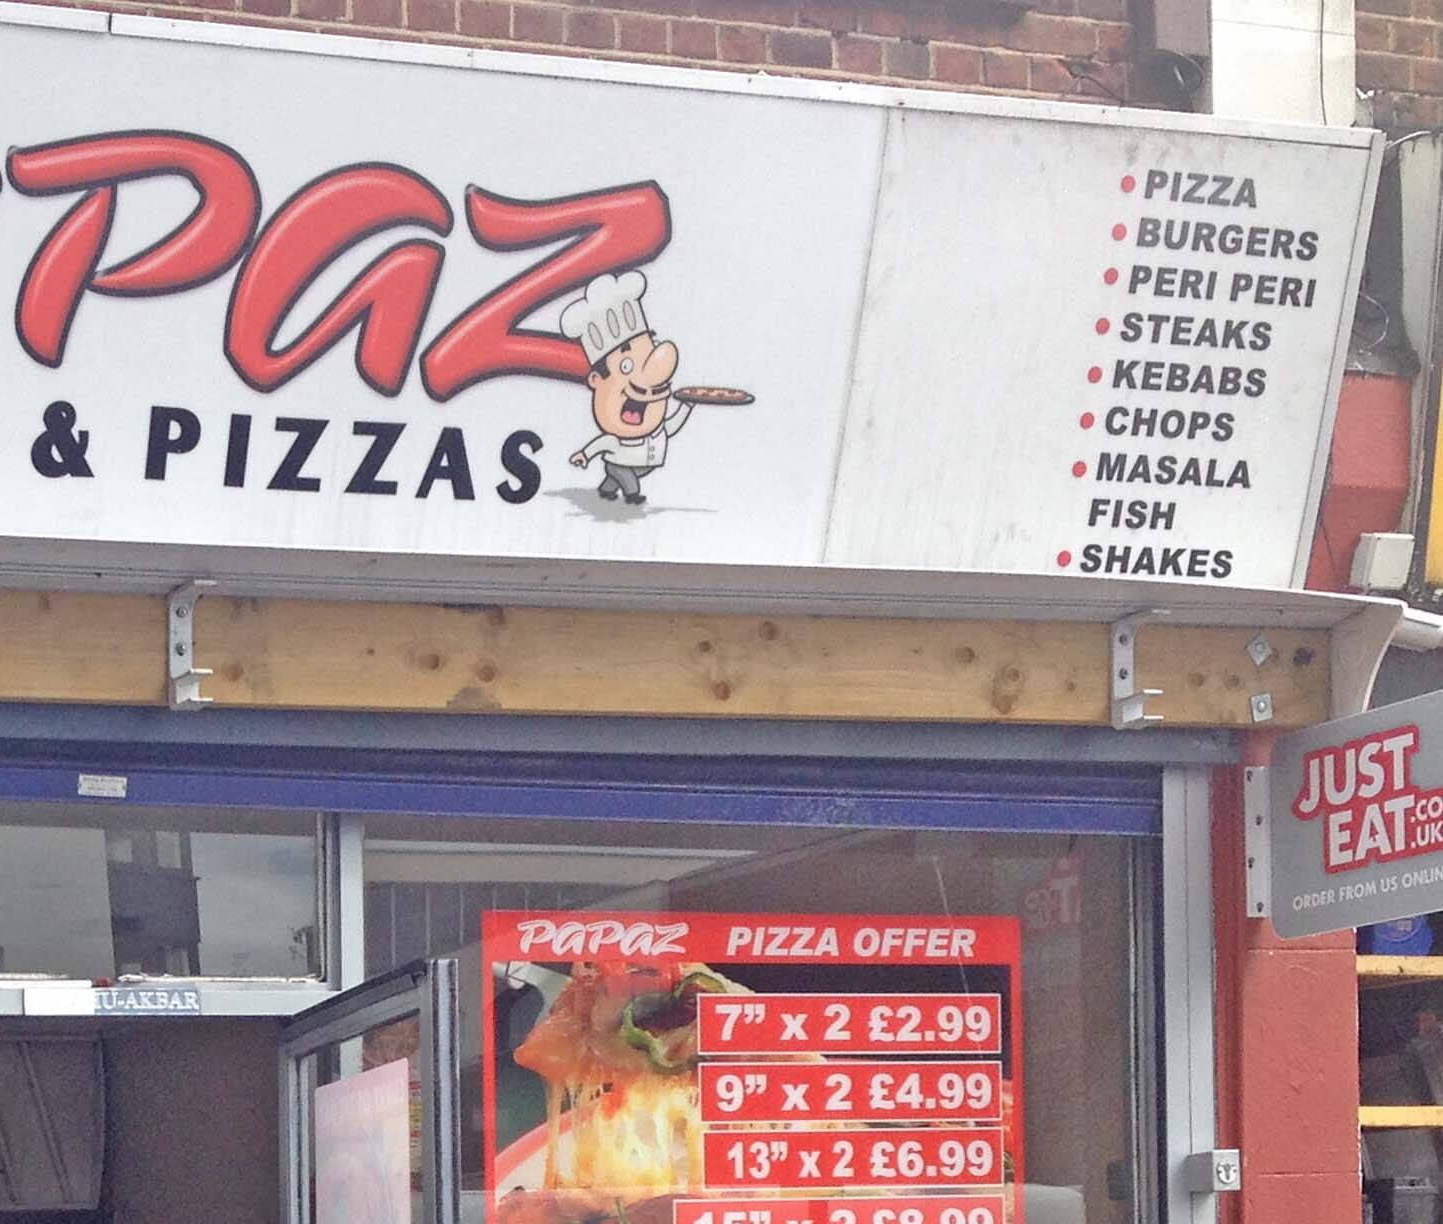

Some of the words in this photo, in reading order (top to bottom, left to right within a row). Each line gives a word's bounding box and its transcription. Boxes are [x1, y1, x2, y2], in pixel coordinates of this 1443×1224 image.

[1143, 169, 1258, 208] PIZZA
[1136, 217, 1319, 261] BURGERS
[1128, 265, 1218, 301] PERI
[1229, 273, 1317, 308] PERI
[1119, 312, 1272, 352] STEAKS
[1112, 359, 1267, 398] KEBABS
[1104, 407, 1235, 442] CHOPS
[31, 401, 94, 479] &
[142, 404, 544, 505] PIZZAS
[1096, 452, 1251, 489] MASALA
[1087, 498, 1176, 531] FISH
[1079, 544, 1233, 579] SHAKES
[1298, 733, 1414, 813] JUST
[1329, 795, 1416, 866] EAT
[1292, 891, 1335, 910] ORDER
[1339, 882, 1377, 904] FROM
[1380, 875, 1398, 893] US
[1401, 865, 1443, 888] ONLIN
[726, 927, 840, 957] PIZZA
[853, 928, 977, 958] OFFER
[780, 1013, 807, 1040] x
[823, 1005, 851, 1040] 2
[868, 1004, 992, 1042] £2.99
[781, 1083, 809, 1110] x
[825, 1074, 853, 1110] 2
[869, 1073, 993, 1110] £4.99
[798, 1150, 821, 1177] x
[832, 1141, 854, 1177] 2
[870, 1139, 993, 1177] £6.99
